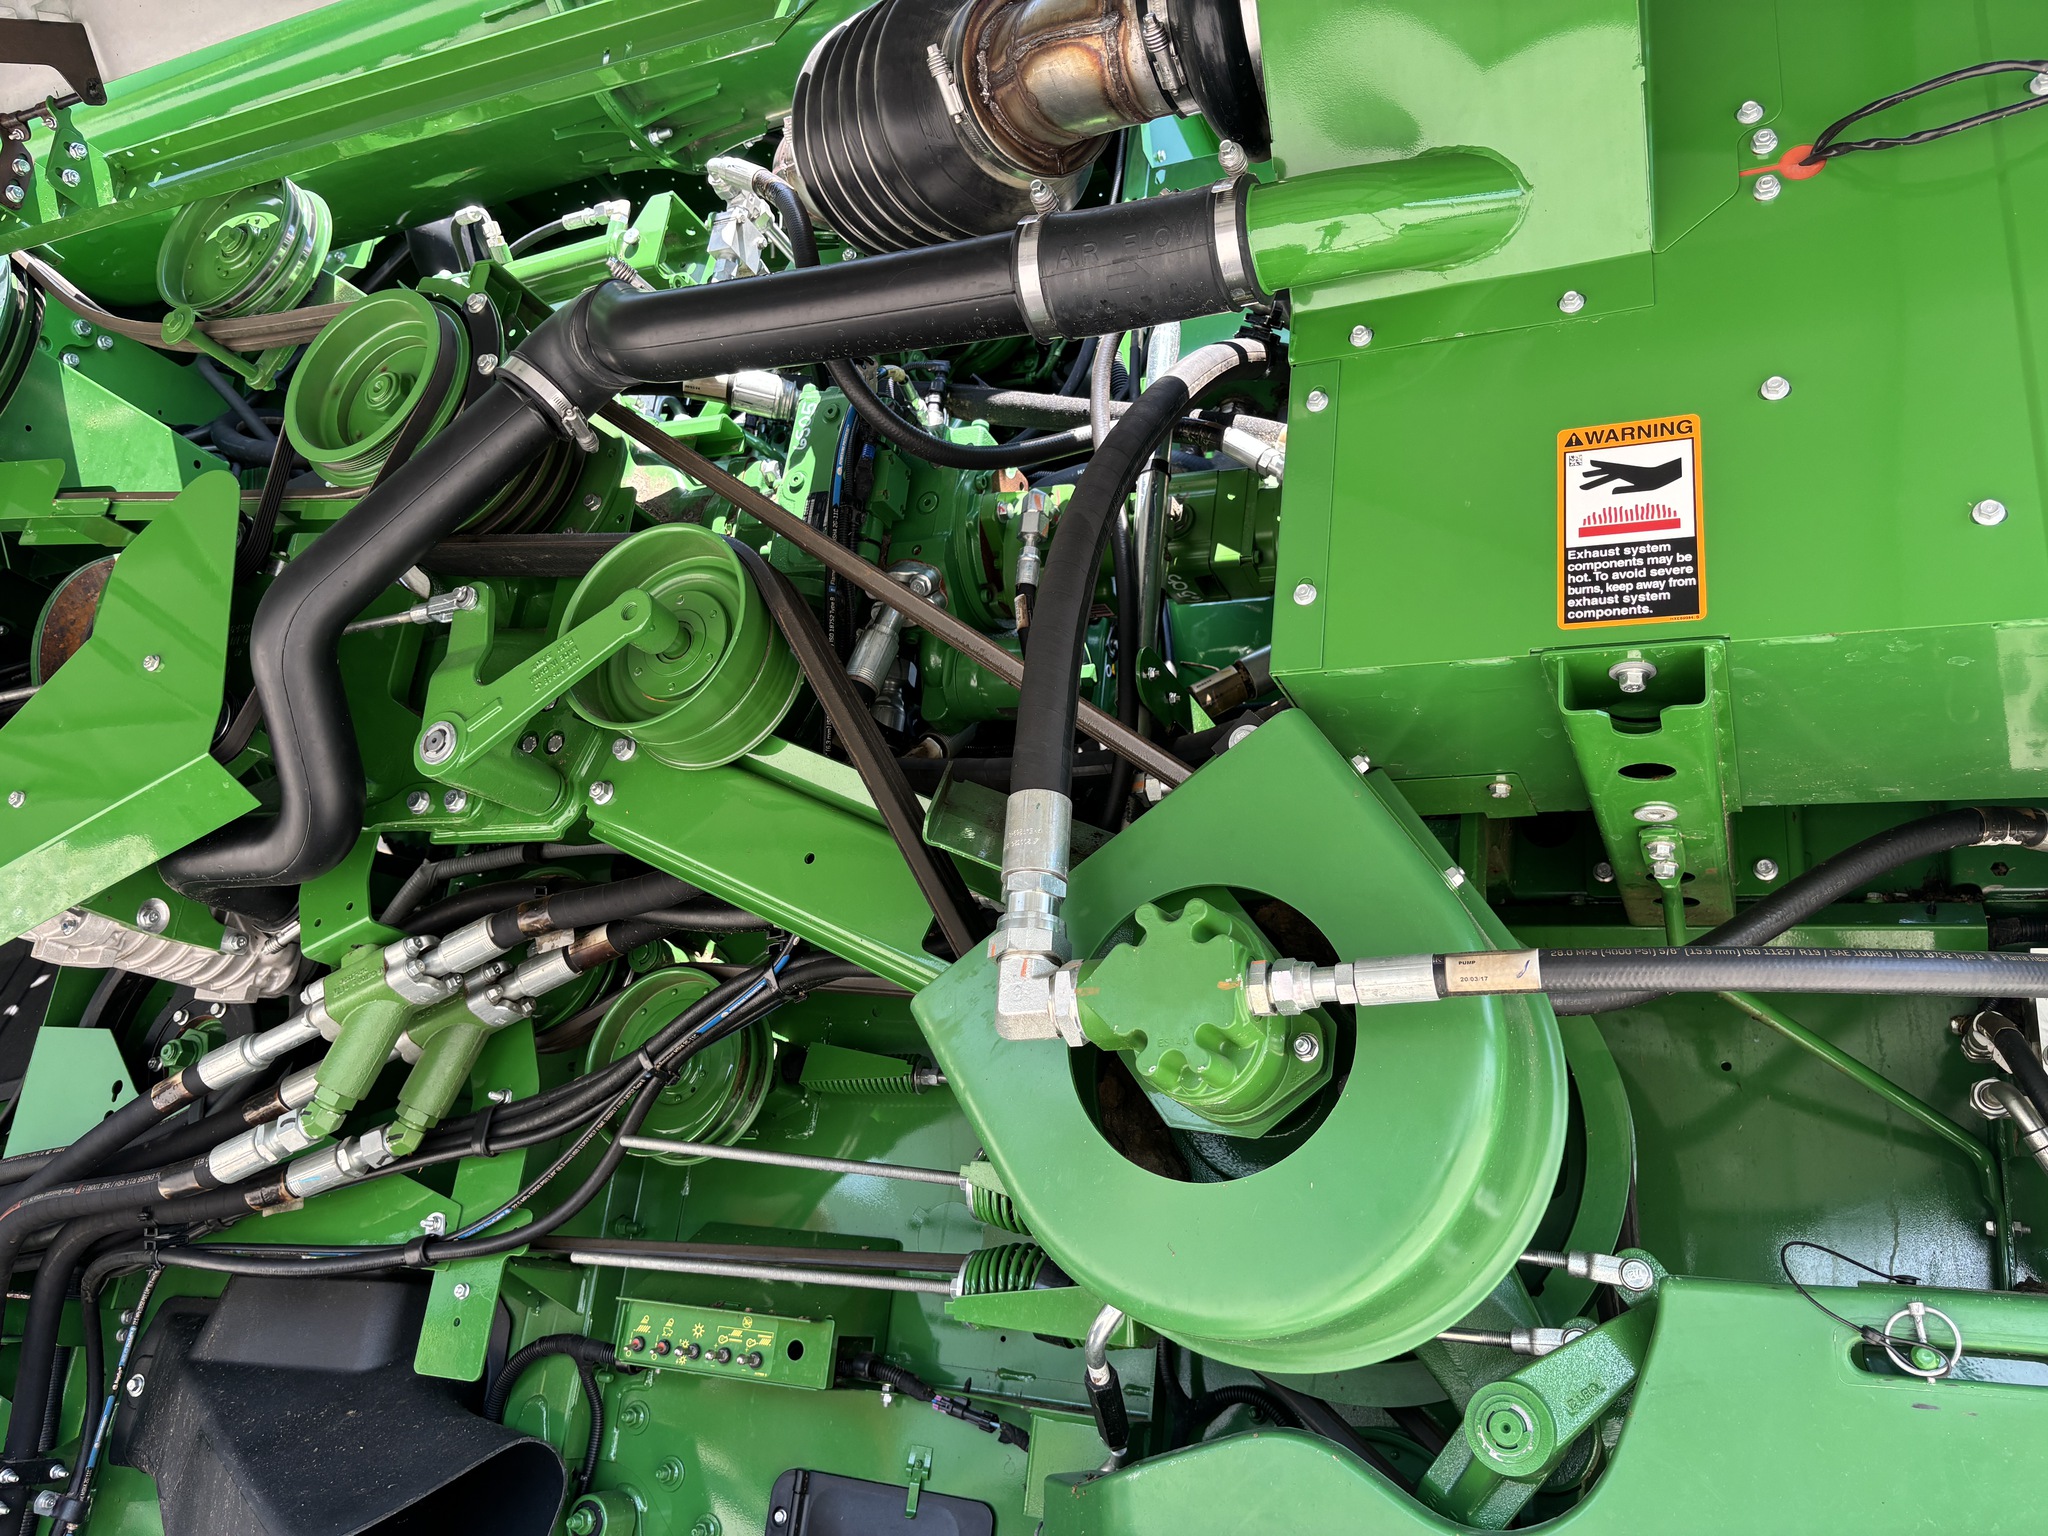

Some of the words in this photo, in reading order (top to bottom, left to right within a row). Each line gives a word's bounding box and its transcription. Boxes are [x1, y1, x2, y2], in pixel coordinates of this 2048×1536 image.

[1056, 241, 1098, 271] AIR
[1122, 222, 1197, 253] FLOW
[1585, 419, 1693, 445] WARNING
[1567, 546, 1620, 560] Exhaust
[1623, 543, 1671, 557] system
[1567, 556, 1644, 573] components
[1646, 555, 1673, 568] may
[1676, 553, 1692, 562] be
[1567, 573, 1591, 583] hot.
[1593, 571, 1608, 581] To
[1612, 567, 1647, 579] avoid
[1649, 565, 1694, 576] severe
[1567, 584, 1604, 596] burns,
[1606, 581, 1634, 595] keep
[1635, 579, 1666, 592] away
[1668, 577, 1697, 587] from
[1567, 595, 1619, 607] exhaust
[1622, 591, 1671, 605] system
[1567, 604, 1654, 620] components.
[1600, 949, 1631, 957] (4000
[1634, 948, 1657, 957] PSI)
[1659, 948, 1681, 956] 5/8"
[1714, 949, 1741, 957] mm)
[1853, 950, 1893, 958] 100R19
[1920, 951, 1951, 959] 18752
[1952, 952, 1976, 961] Type
[2000, 953, 2029, 962] Flame
